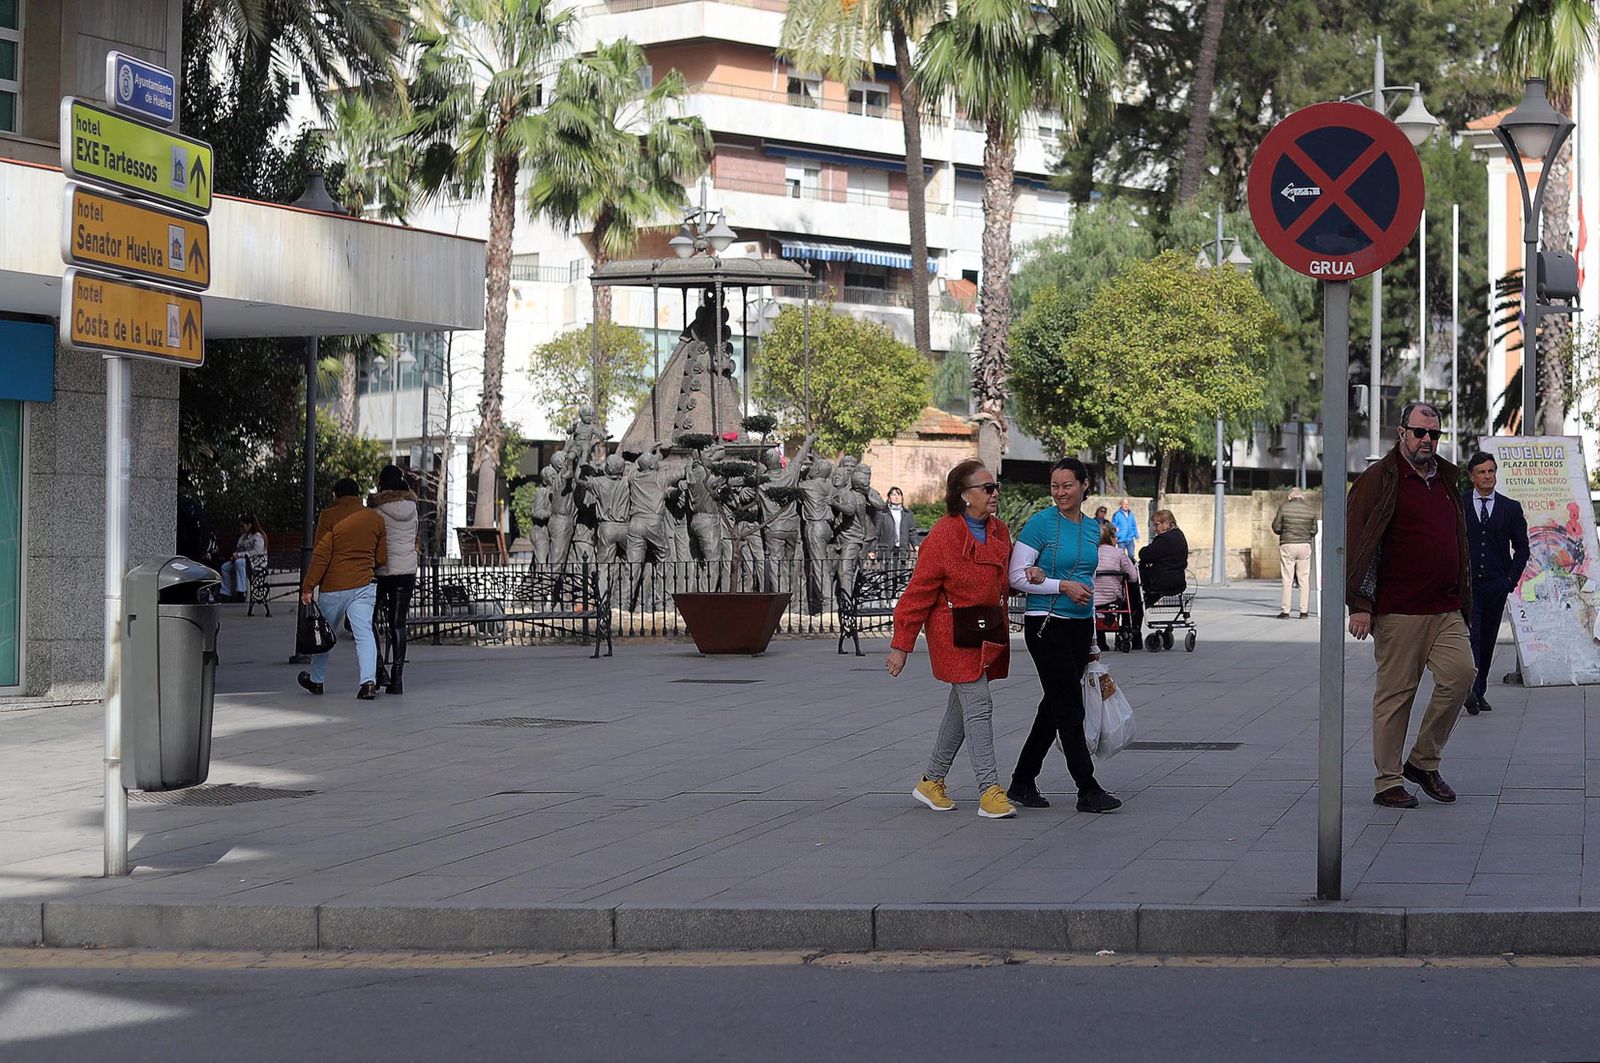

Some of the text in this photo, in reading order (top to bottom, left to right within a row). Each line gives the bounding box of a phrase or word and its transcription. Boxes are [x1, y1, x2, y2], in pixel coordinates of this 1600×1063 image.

[135, 73, 172, 96] Ayuntamiento
[145, 92, 171, 110] de Huelva
[76, 113, 101, 137] hotel
[76, 137, 158, 183] EXE Tartessos
[77, 199, 104, 222] hotel
[77, 224, 163, 267] Senator Huelva
[1309, 260, 1356, 275] GRUA
[77, 281, 103, 304] hotel
[76, 309, 163, 347] Costa de la Luz
[1498, 446, 1565, 460] HUELVA
[1511, 468, 1559, 476] LA MERCED
[1520, 609, 1527, 618] 2
